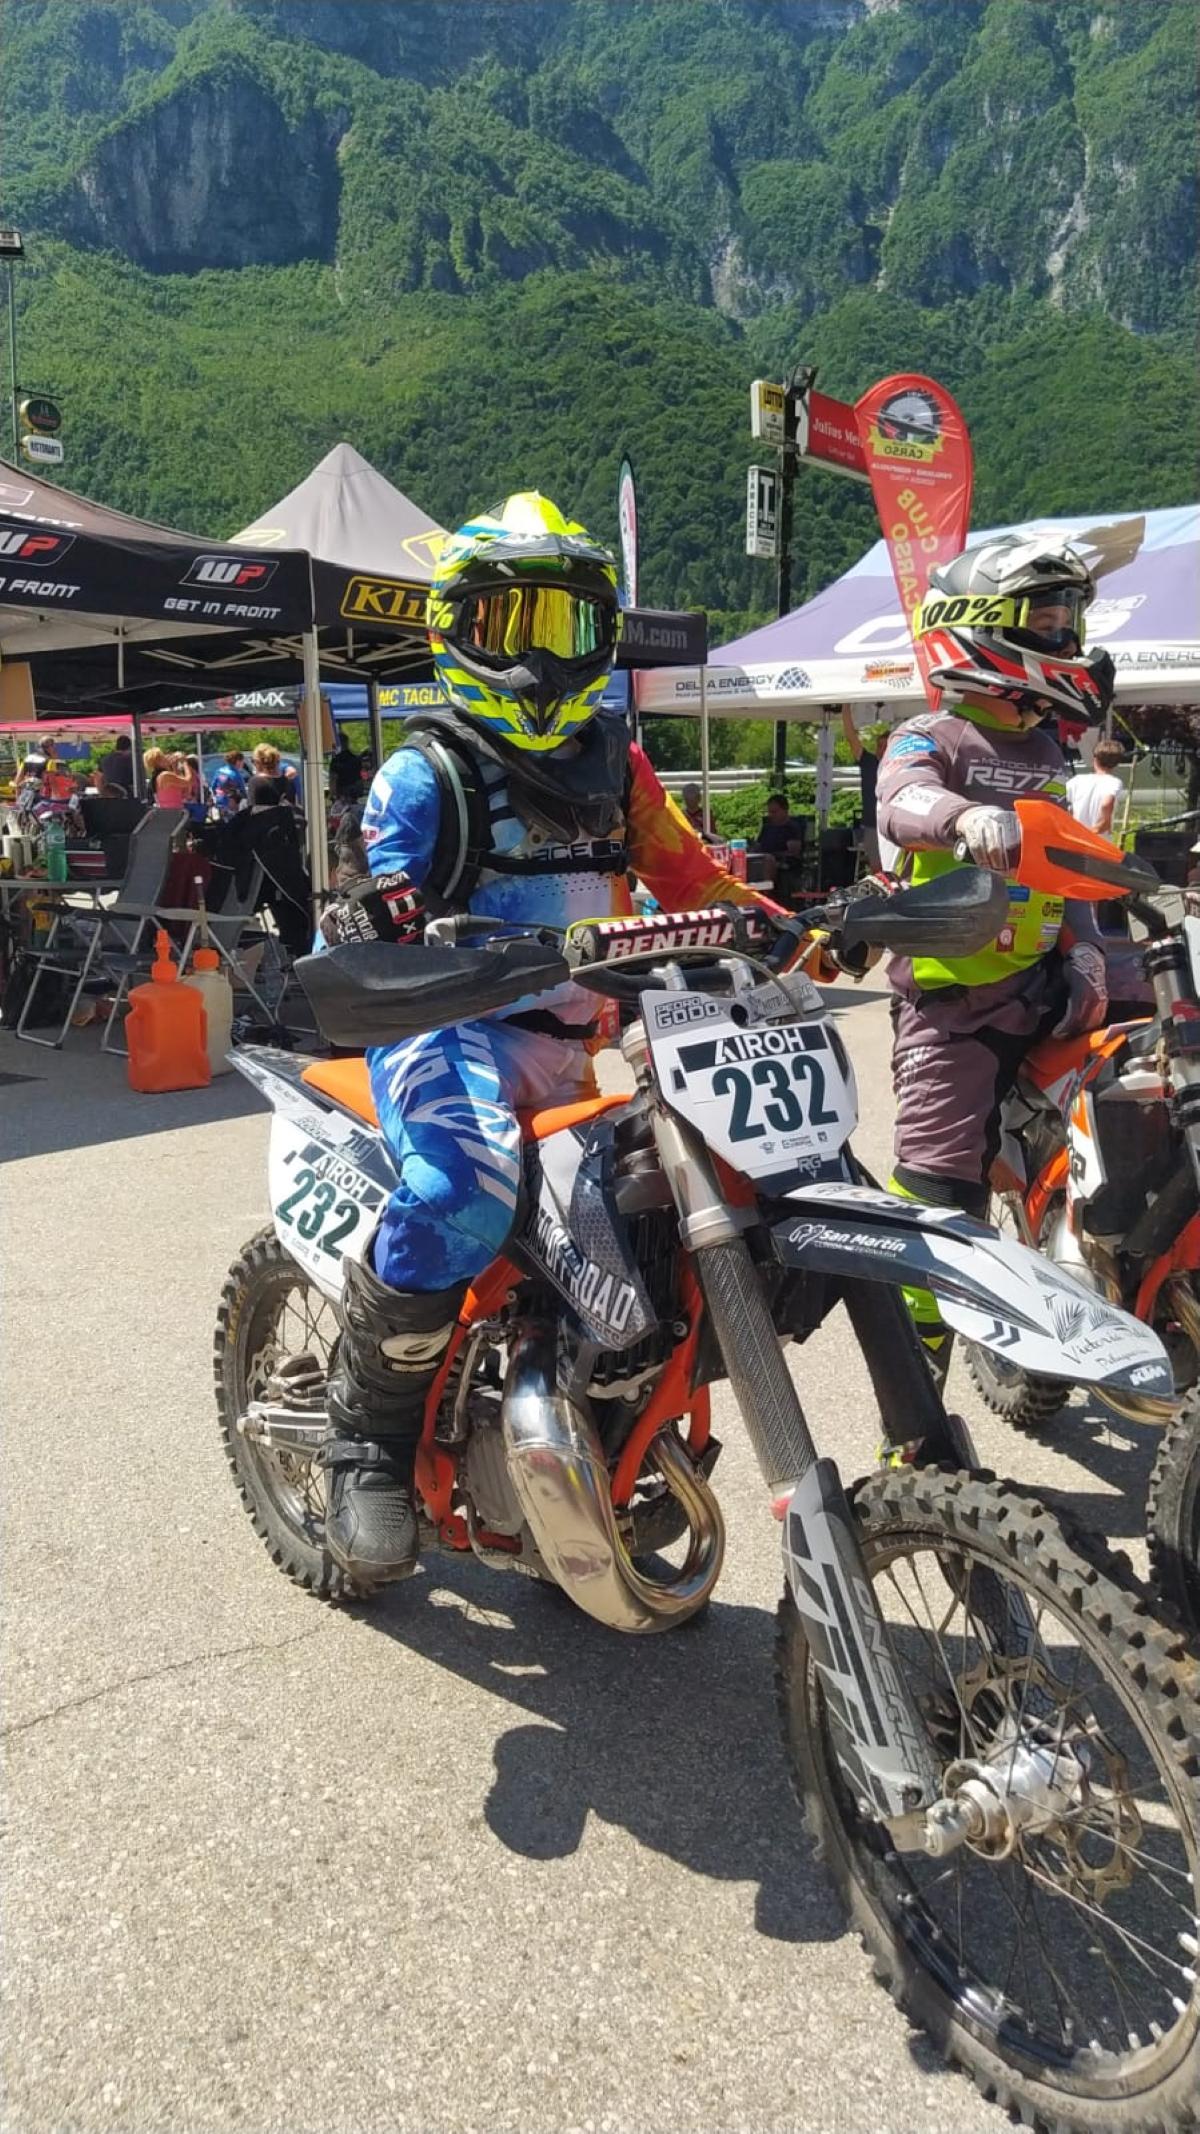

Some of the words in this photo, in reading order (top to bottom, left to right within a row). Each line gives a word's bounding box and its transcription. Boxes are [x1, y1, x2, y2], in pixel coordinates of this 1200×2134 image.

[196, 561, 267, 585] WP
[8, 579, 81, 599] FRONT
[352, 584, 425, 618] Kli
[164, 597, 200, 612] GET
[202, 601, 221, 614] IN
[223, 603, 281, 619] FRONT
[922, 598, 1006, 629] 100%
[675, 680, 716, 691] DELA
[718, 674, 776, 689] ENERGY
[234, 692, 286, 708] 24MX
[379, 688, 400, 705] MC
[965, 765, 1051, 791] RS77
[715, 1028, 807, 1065] AIROH
[711, 1054, 840, 1143] 232
[313, 1154, 370, 1202] AIROH
[275, 1168, 361, 1261] 232
[820, 1228, 850, 1244] San
[1130, 1364, 1167, 1387] KTM
